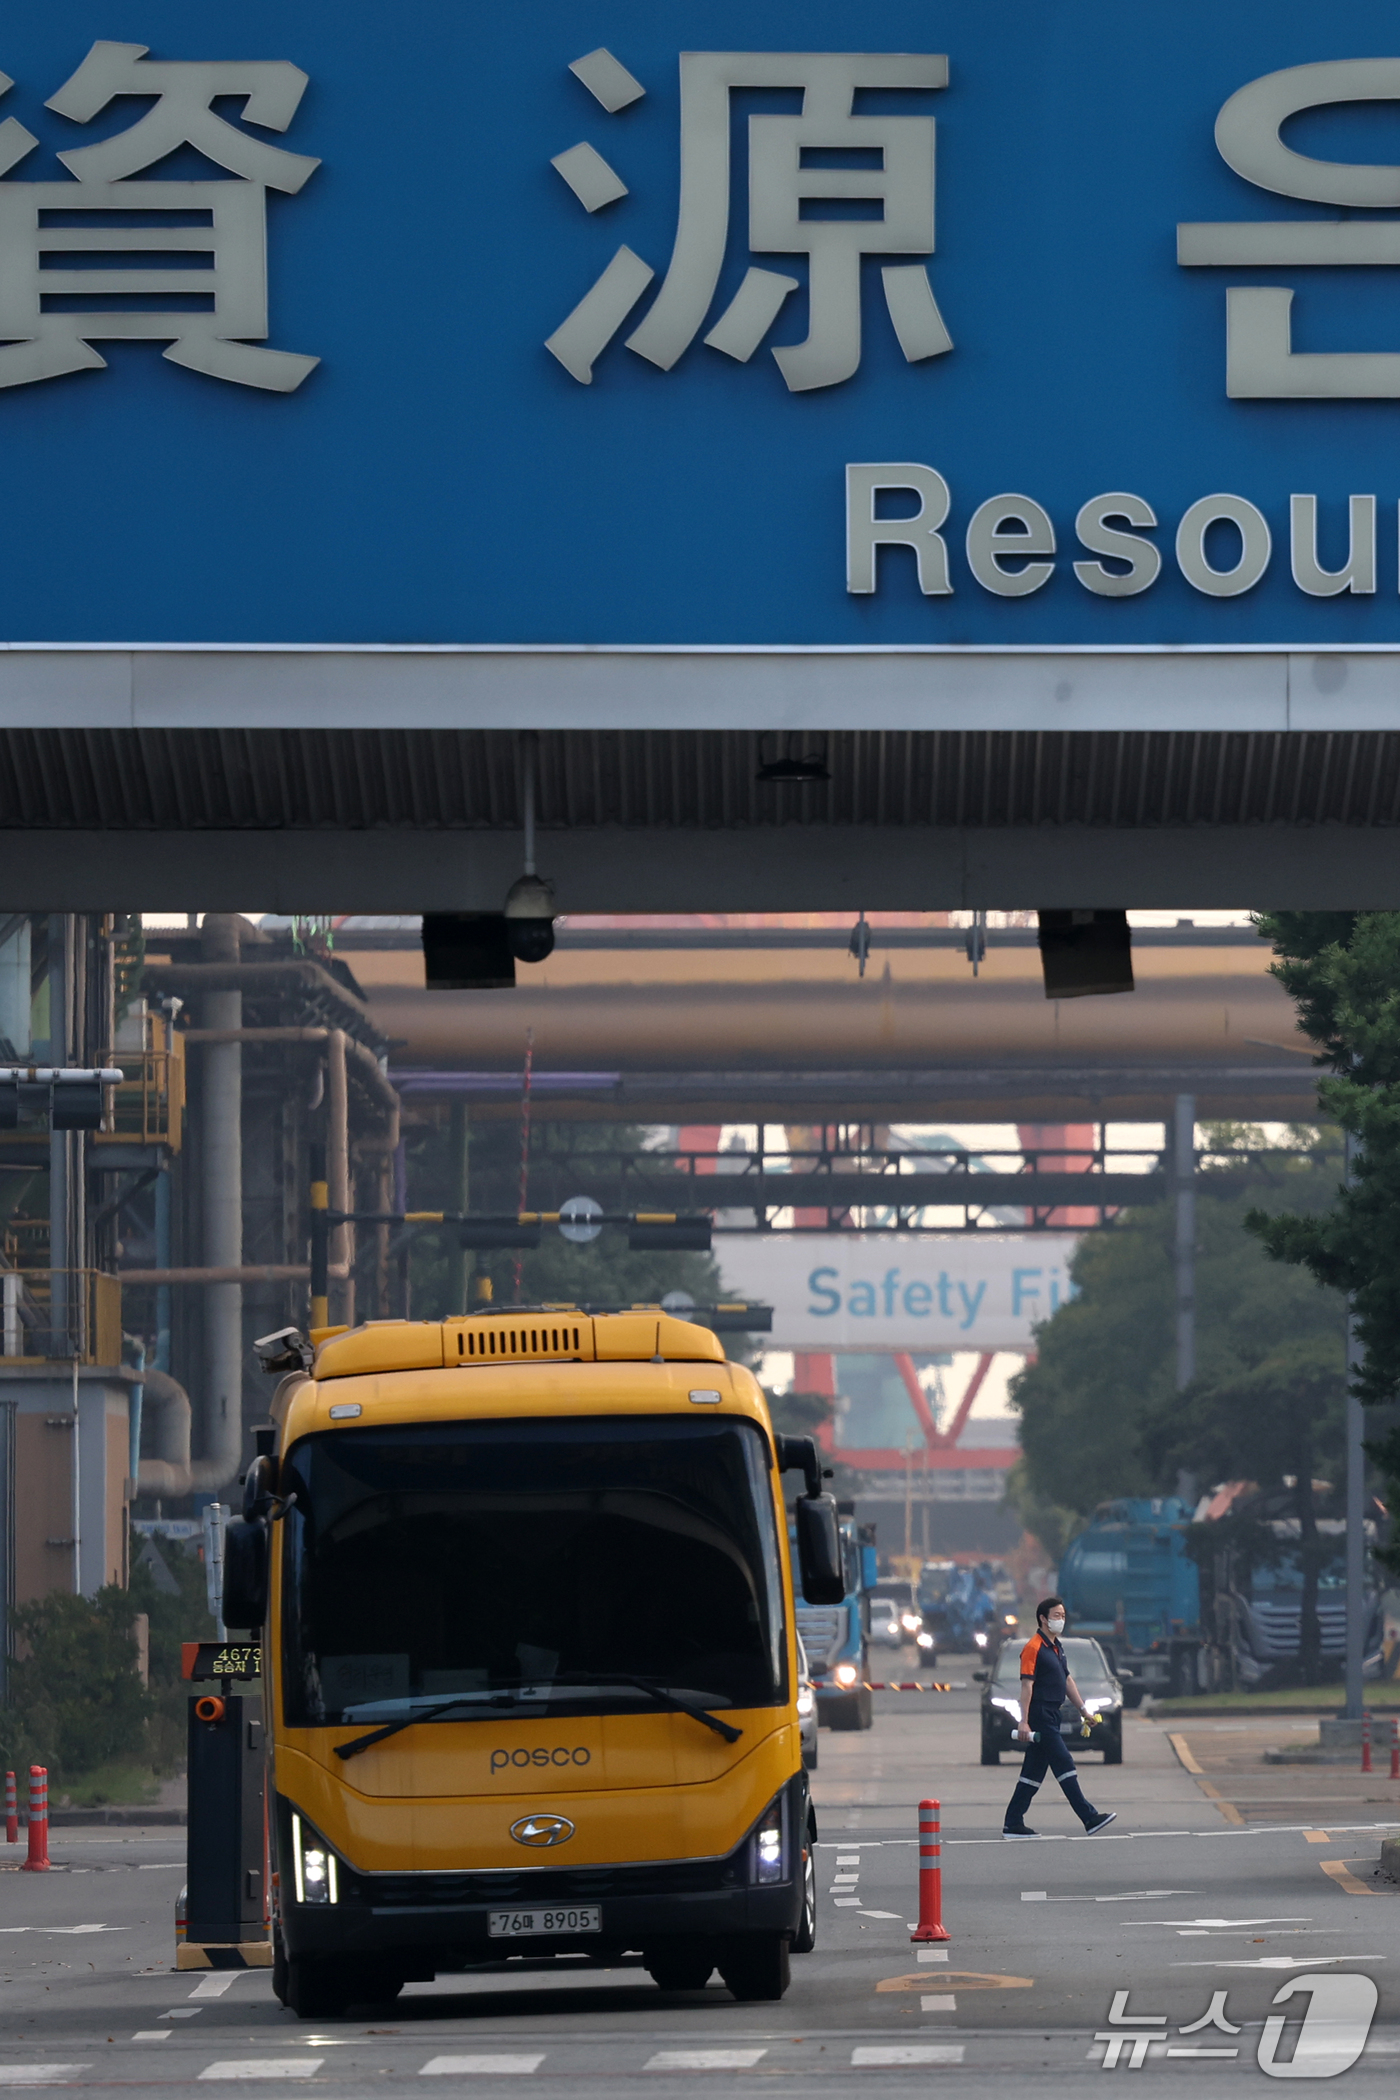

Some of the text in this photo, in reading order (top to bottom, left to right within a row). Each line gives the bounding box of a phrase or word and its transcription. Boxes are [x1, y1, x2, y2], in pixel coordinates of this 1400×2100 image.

[845, 462, 1400, 597] Resou
[807, 1266, 987, 1330] Safety
[213, 1660, 246, 1673] 동승자
[218, 1648, 261, 1661] 4673
[490, 1747, 591, 1775] posco
[499, 1911, 590, 1931] 76마 8905
